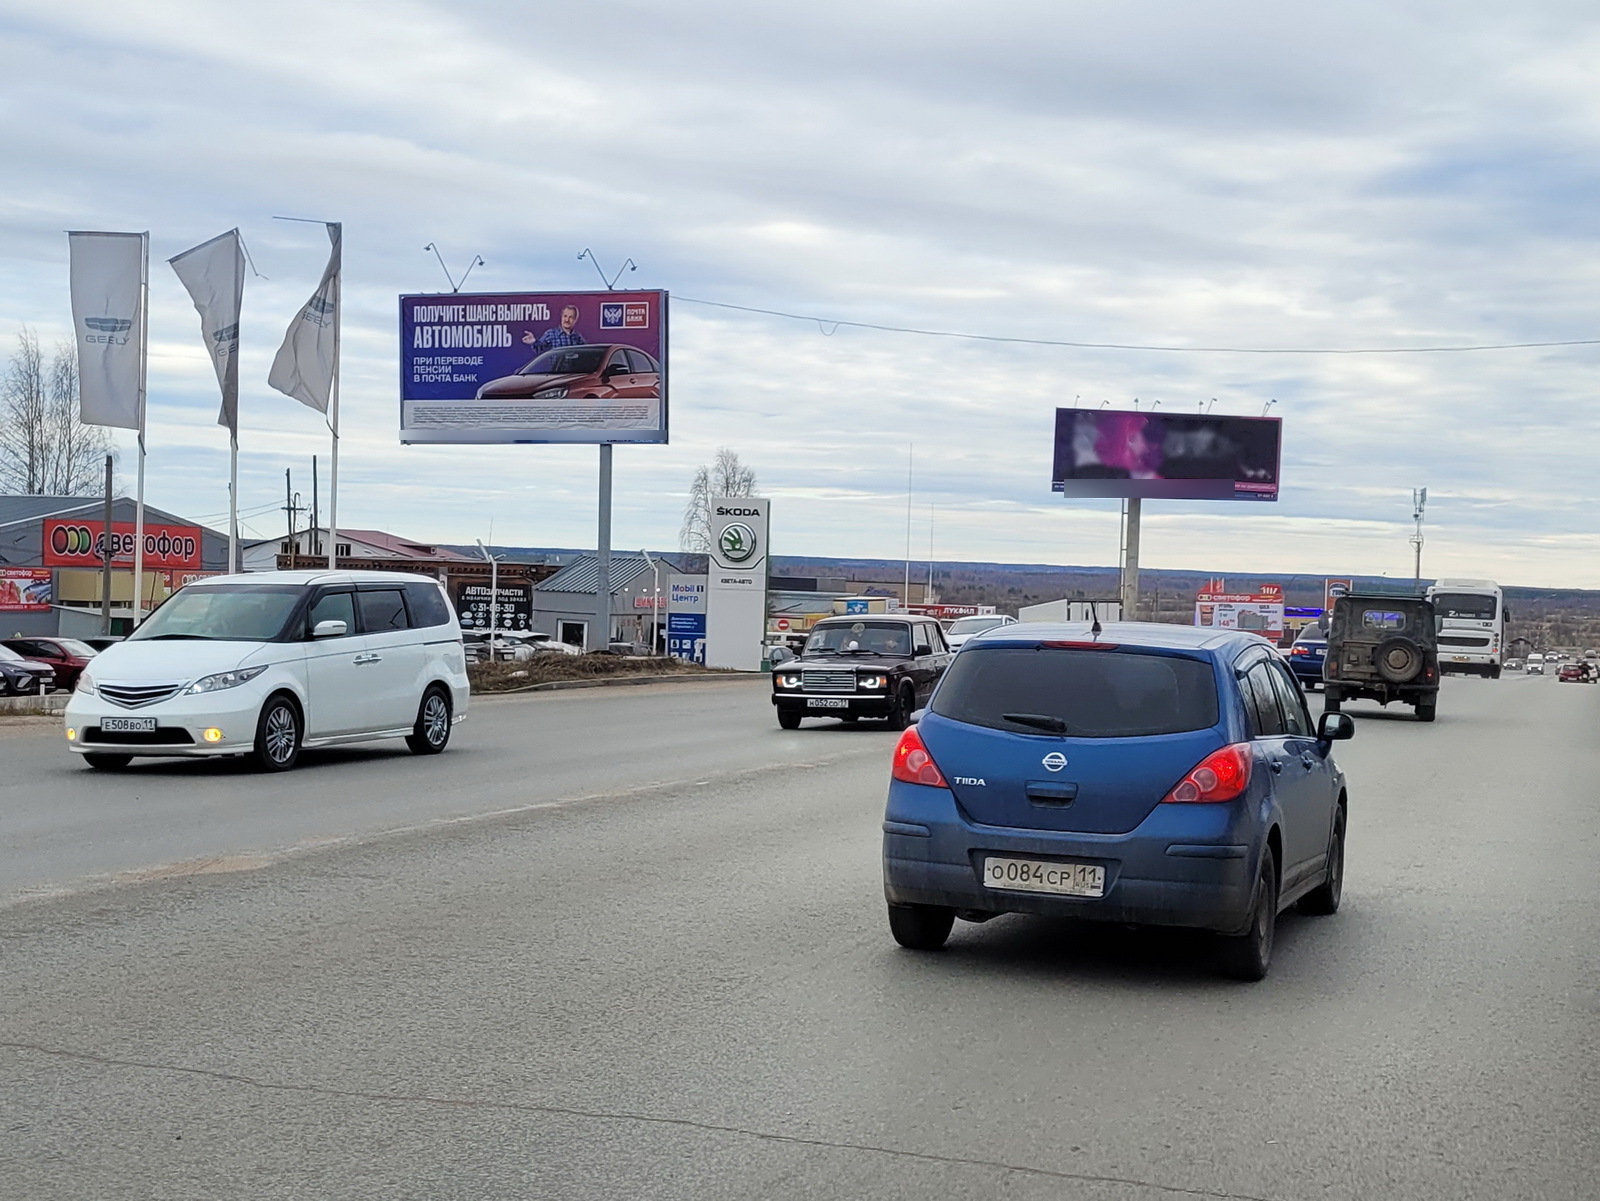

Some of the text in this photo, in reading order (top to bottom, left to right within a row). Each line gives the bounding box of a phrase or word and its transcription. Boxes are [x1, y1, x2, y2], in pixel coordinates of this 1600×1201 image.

[413, 303, 551, 323] ПОЛУЧИТЕ ШАНС ВЫИГРАТЬ
[627, 308, 646, 316] ПОЧТА
[85, 335, 130, 345] GEELY
[413, 324, 512, 348] АВТОМОБИЛЬ
[413, 356, 484, 366] ПРИ ПЕРЕВОДЕ
[413, 365, 452, 374] ПЕНСИИ
[413, 373, 478, 382] В ПОЧТА БАНК
[716, 506, 760, 517] ŠKODA
[671, 584, 695, 592] Mobil
[671, 593, 699, 603] Центр
[953, 776, 987, 786] TIIDA
[992, 862, 1097, 886] О084СР 11
